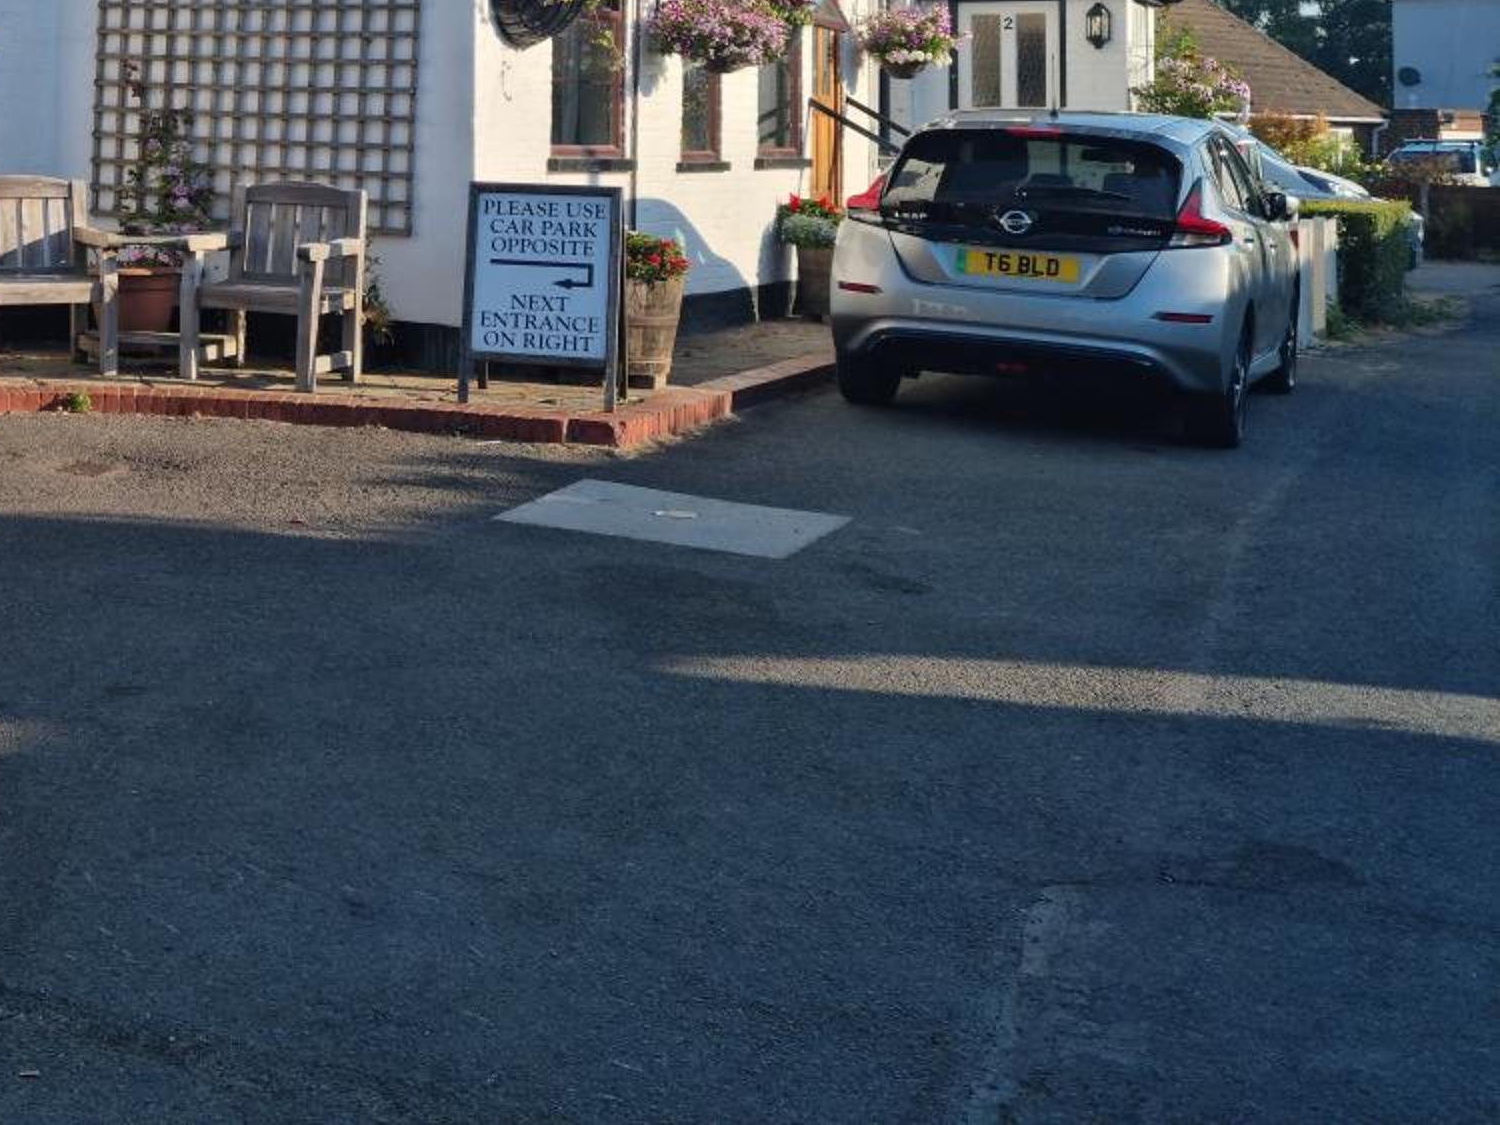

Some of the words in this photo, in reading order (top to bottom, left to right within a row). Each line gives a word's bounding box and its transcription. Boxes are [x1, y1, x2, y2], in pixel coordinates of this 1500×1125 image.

[1003, 16, 1013, 30] 2
[484, 199, 559, 217] PLEASE
[567, 202, 606, 220] USE
[490, 219, 534, 236] CAR
[541, 220, 597, 238] PARK
[491, 238, 595, 256] OPPOSITE
[985, 251, 1011, 272] T6
[1018, 255, 1060, 277] BLD
[511, 294, 570, 312] NEXT
[481, 311, 599, 334] ENTRANCE
[483, 331, 515, 347] ON
[523, 332, 595, 352] RIGHT
